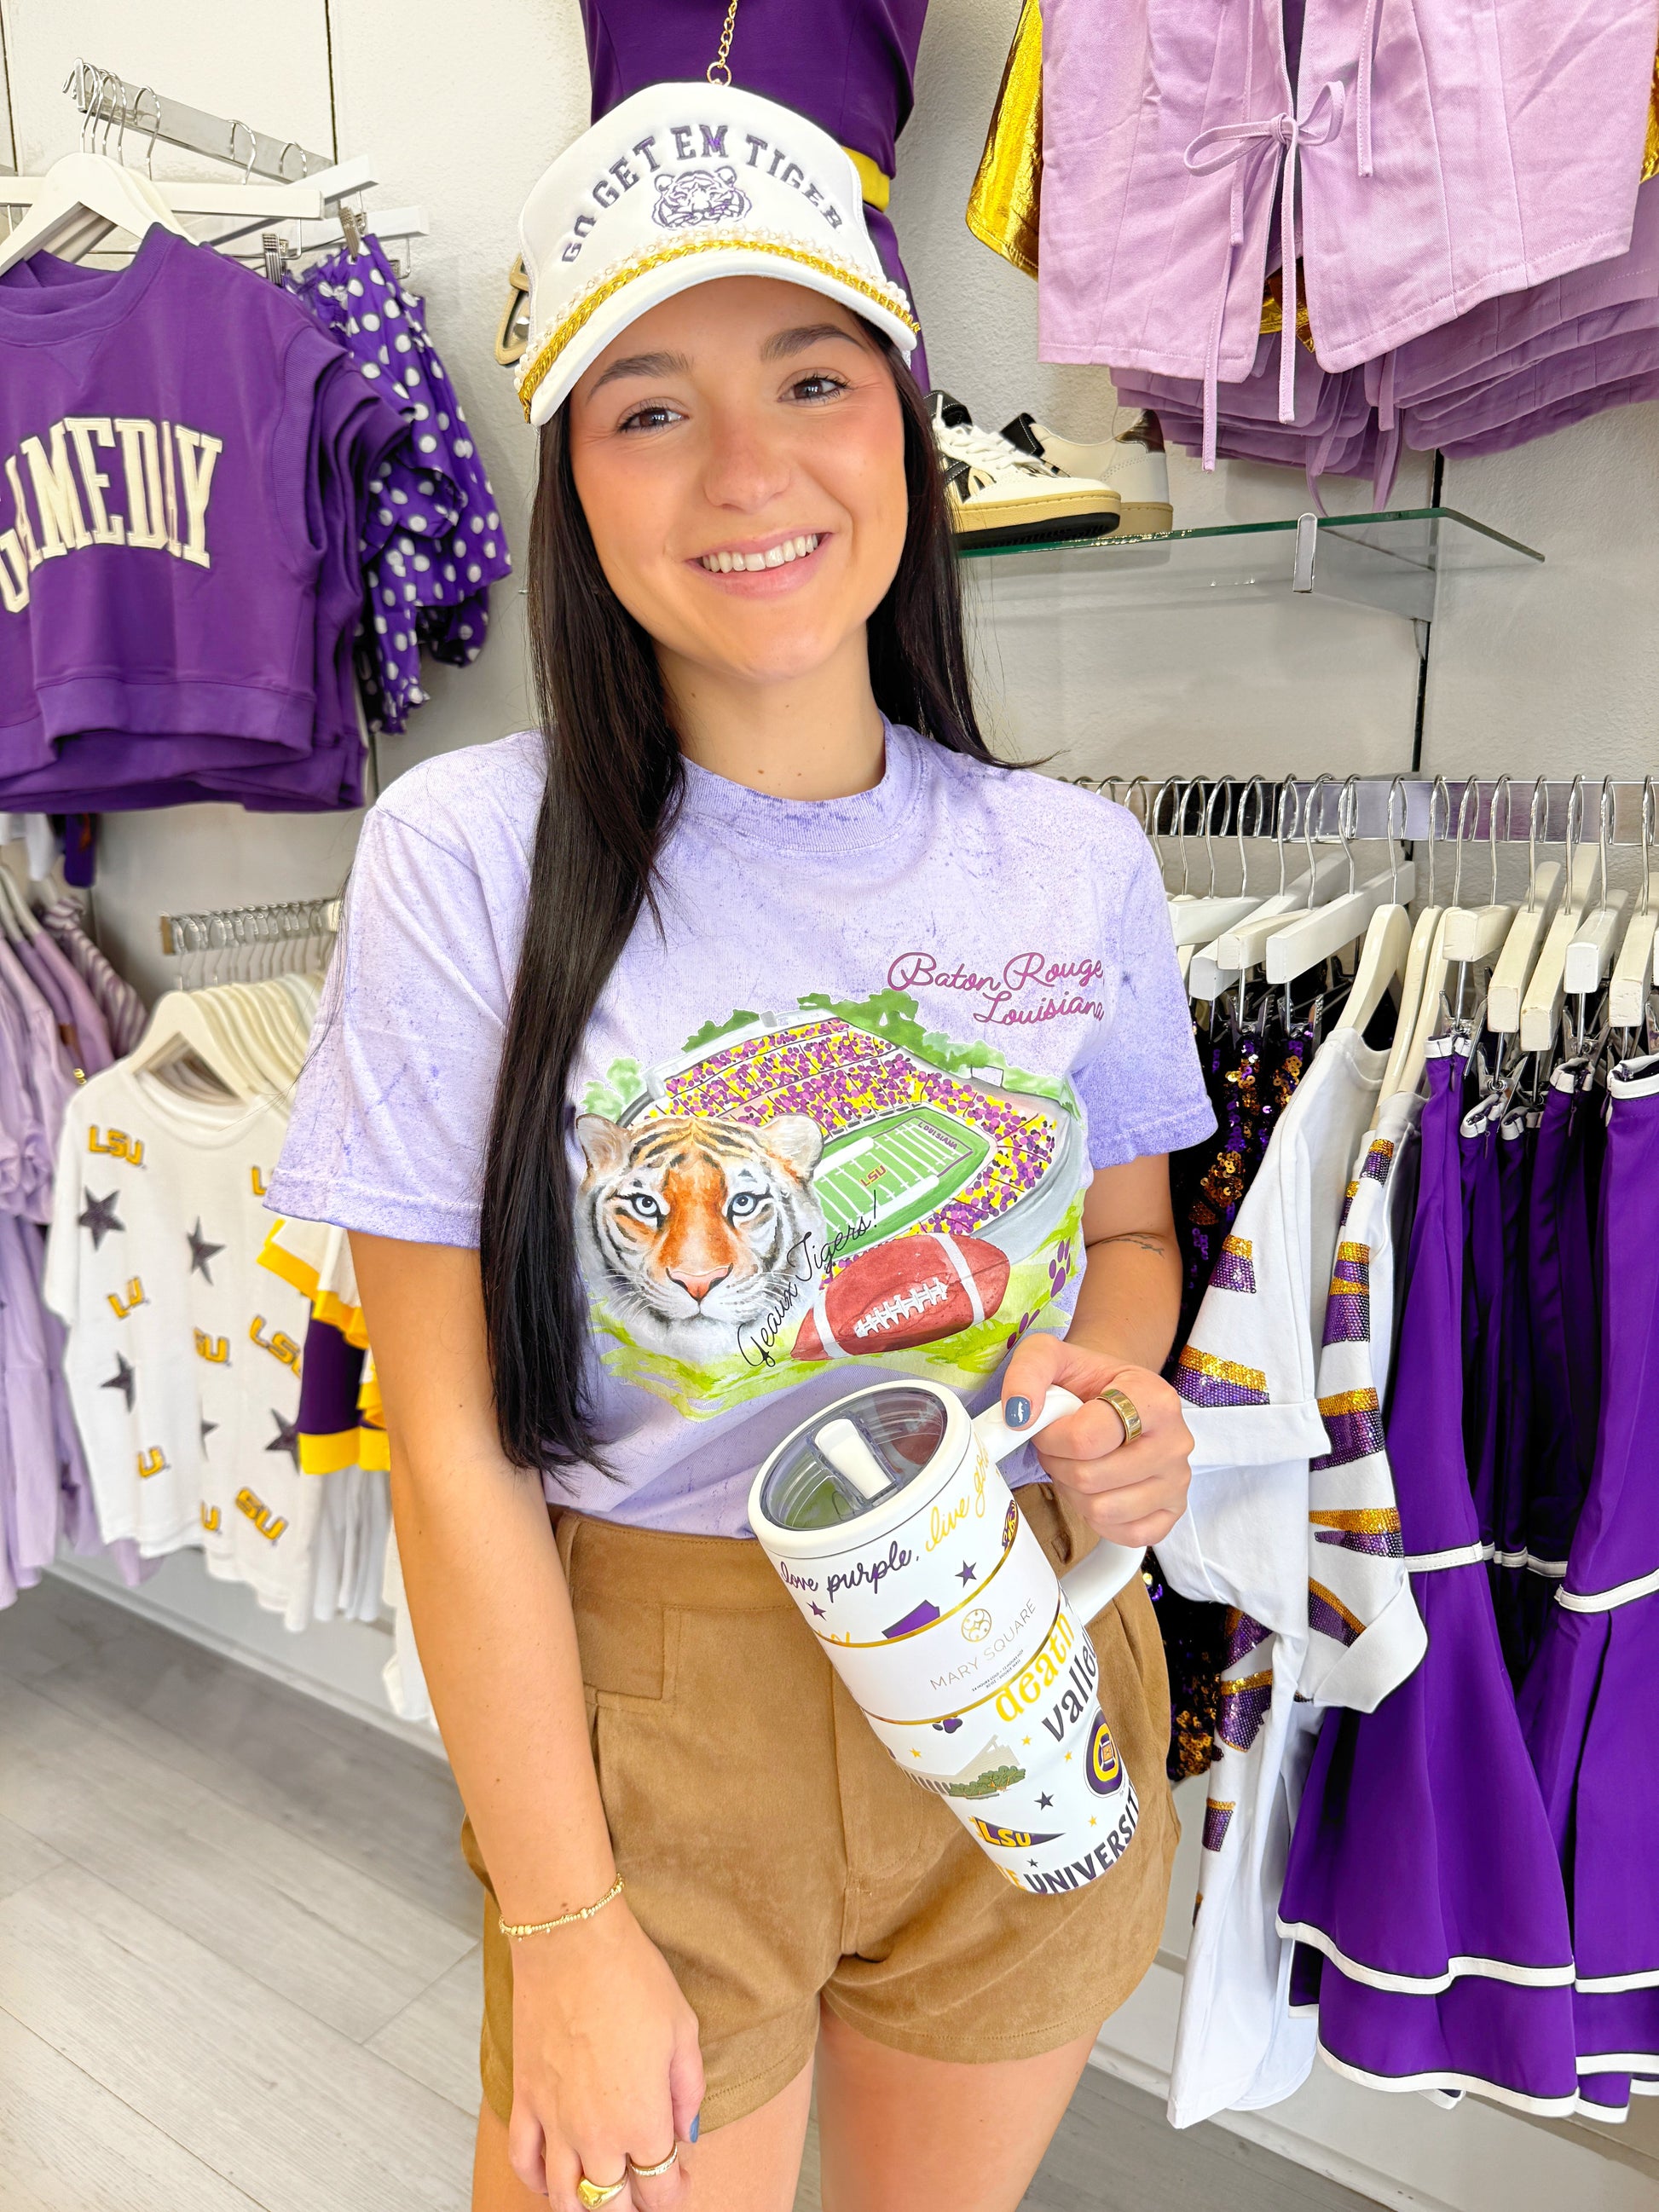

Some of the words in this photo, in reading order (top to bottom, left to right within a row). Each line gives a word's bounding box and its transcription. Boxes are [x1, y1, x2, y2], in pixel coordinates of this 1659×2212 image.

[561, 214, 597, 263] GO
[592, 135, 661, 209] GET
[670, 124, 730, 161] EM
[745, 133, 843, 230] TIGER
[887, 951, 1002, 991] Baton
[88, 1124, 145, 1167] LSU
[917, 1121, 958, 1150] LOUISIANA
[859, 1164, 887, 1188] LSU
[737, 1281, 799, 1368] Geaux
[786, 1189, 878, 1282] Tigers!
[780, 1561, 818, 1591] love
[925, 1494, 970, 1552] live
[929, 1656, 979, 1690] MARY
[983, 1598, 1037, 1660] SQUARE
[978, 1819, 1032, 1848] LSU
